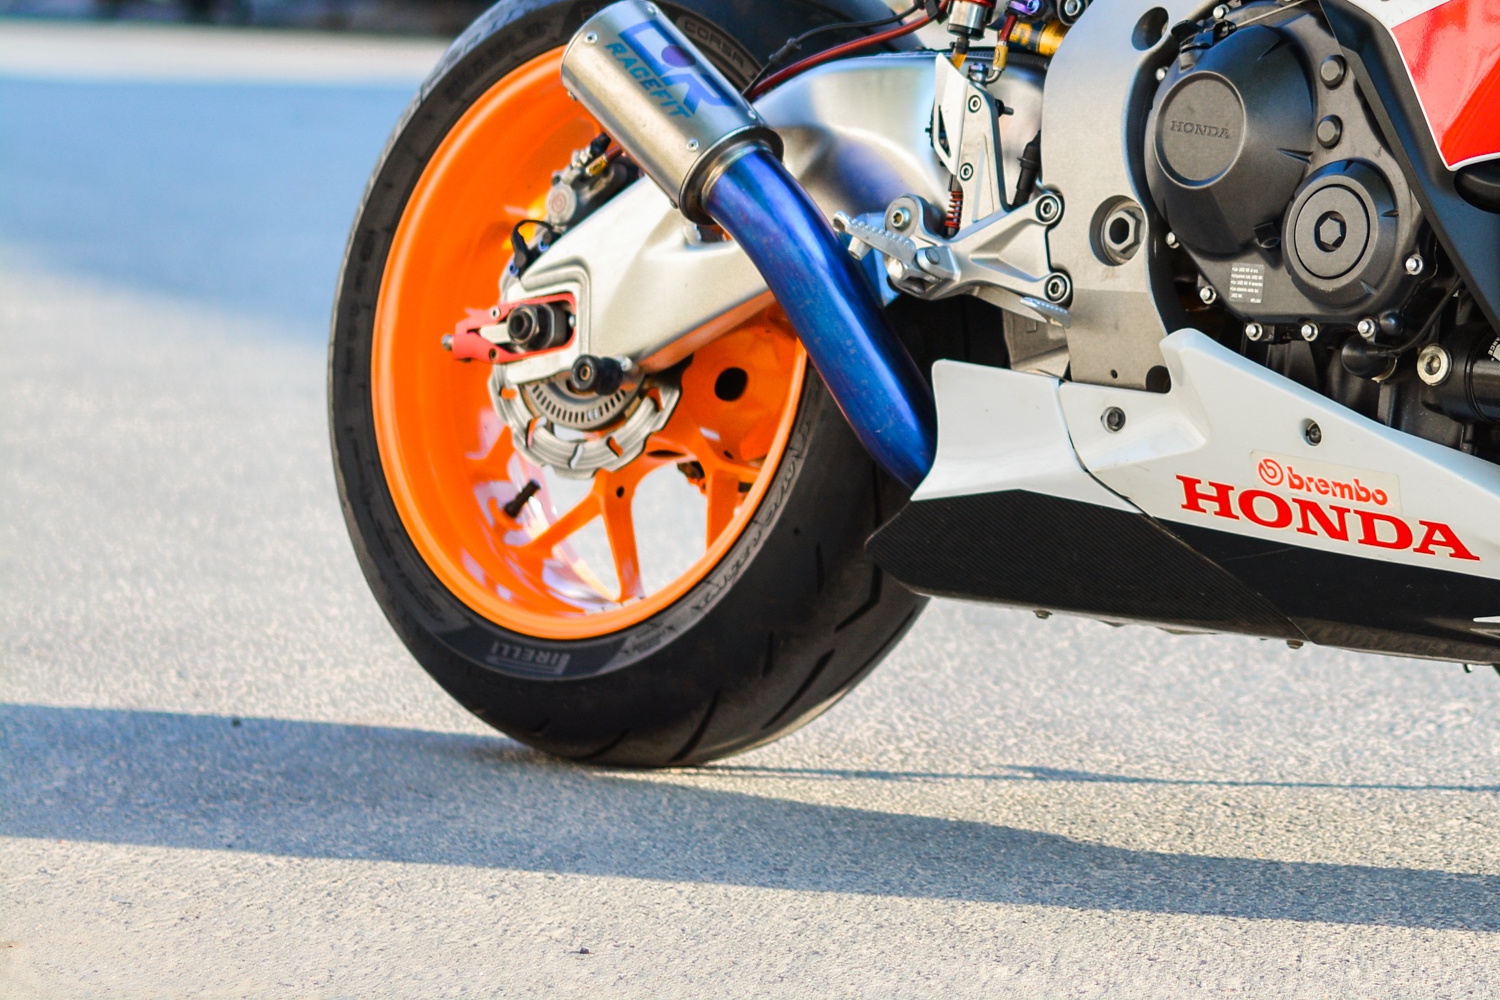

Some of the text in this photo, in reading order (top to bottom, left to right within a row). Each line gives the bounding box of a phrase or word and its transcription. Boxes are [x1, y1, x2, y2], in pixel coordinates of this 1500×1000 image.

[605, 42, 692, 120] RACEFIT
[1170, 120, 1231, 140] HONDA
[1287, 465, 1390, 506] brembo
[1176, 474, 1481, 562] HONDA
[486, 640, 572, 675] PIRELLI
